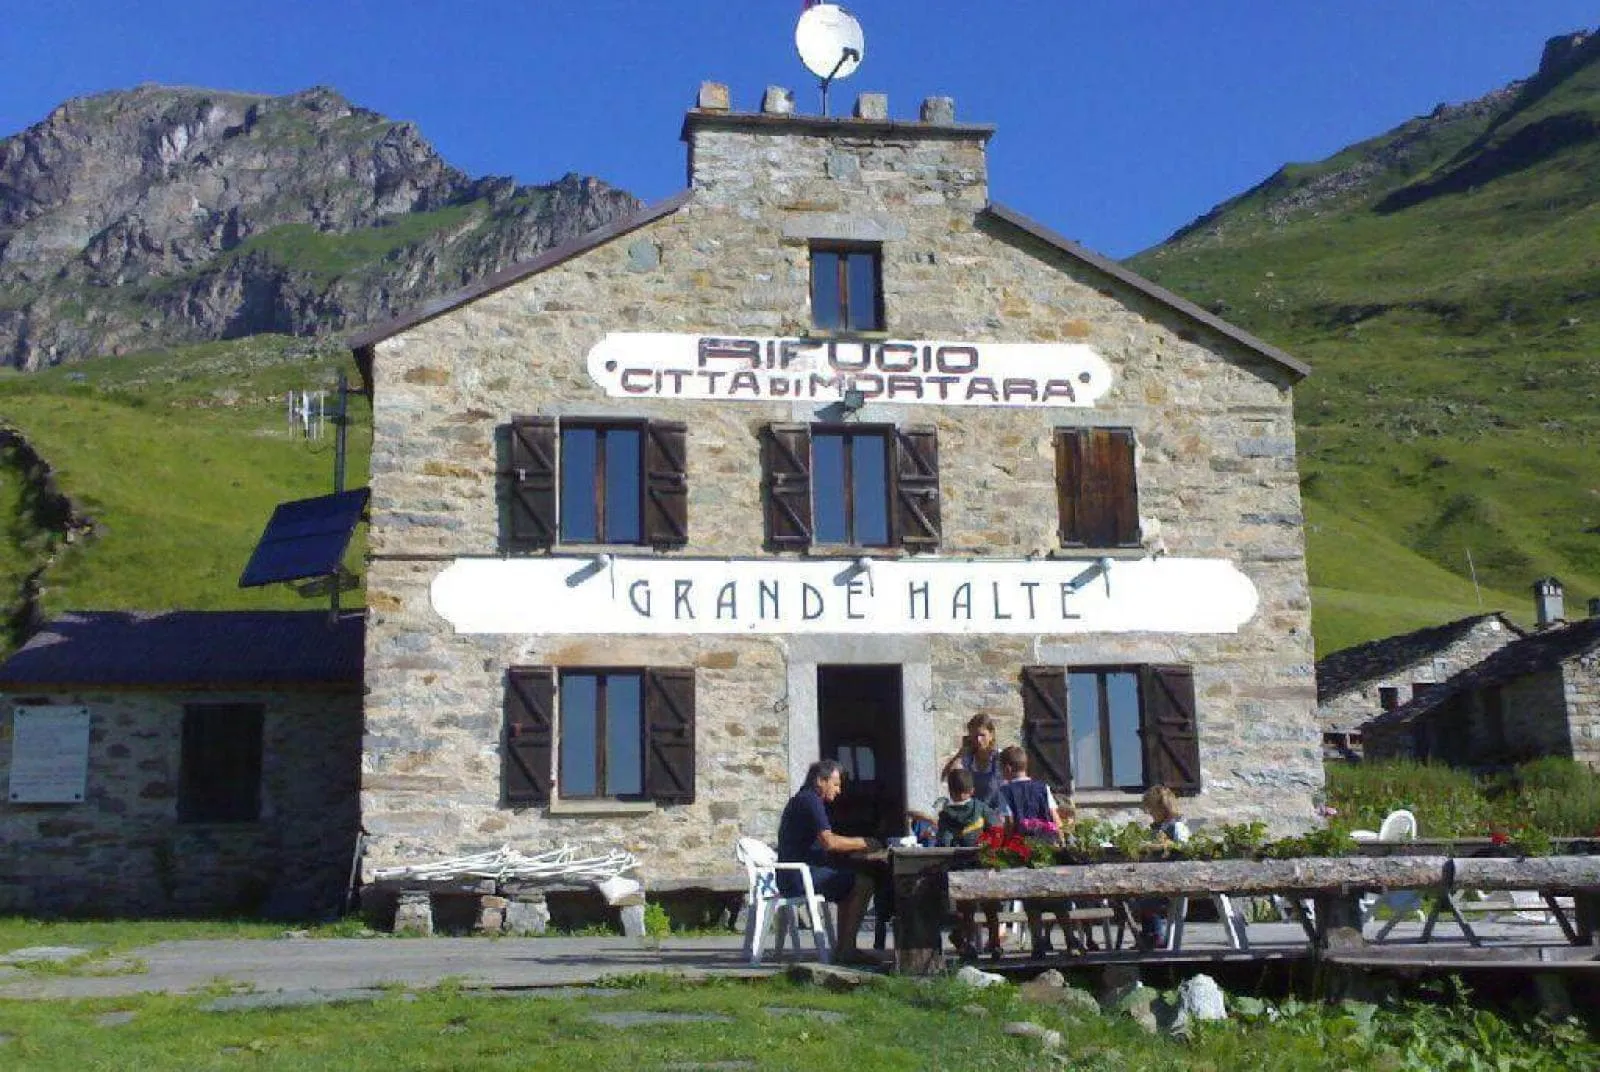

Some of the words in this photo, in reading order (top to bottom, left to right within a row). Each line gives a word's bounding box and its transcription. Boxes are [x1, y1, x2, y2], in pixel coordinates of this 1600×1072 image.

[698, 337, 978, 374] RIFUGIO
[809, 371, 1076, 402] MORTARA
[629, 579, 866, 620] GRANDE
[908, 580, 1082, 620] HALTE
